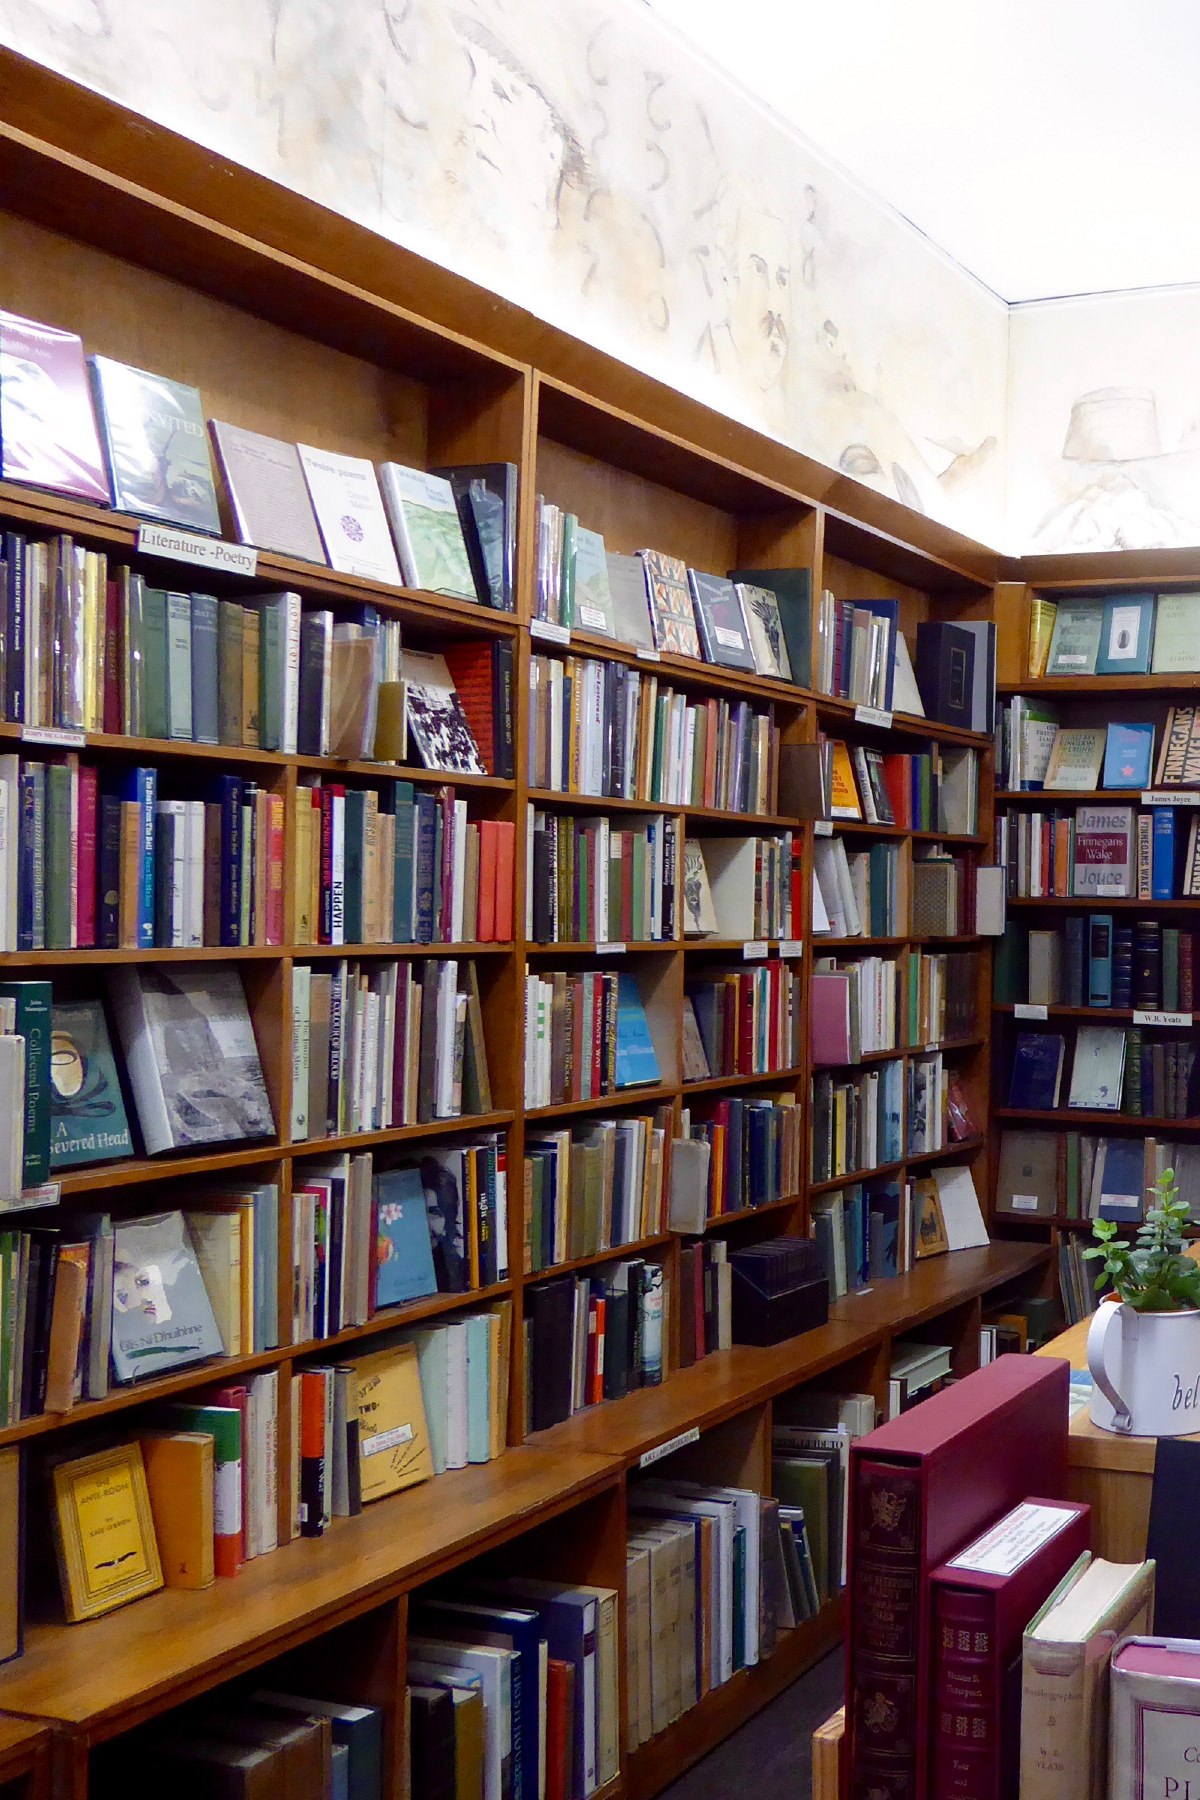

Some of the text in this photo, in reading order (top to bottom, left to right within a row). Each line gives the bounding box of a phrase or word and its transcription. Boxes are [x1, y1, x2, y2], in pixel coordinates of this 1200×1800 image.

[141, 528, 206, 557] Literature
[1163, 706, 1194, 785] FINNEGANS
[1150, 794, 1192, 805] James Joyce
[1078, 810, 1127, 829] James
[1077, 836, 1124, 849] Finnegans
[1086, 849, 1113, 860] Wake
[1140, 821, 1150, 893] FINNEGANS WAKE
[333, 881, 343, 928] HAPPEN
[333, 1000, 341, 1035] COLOUR
[1162, 1015, 1182, 1024] Yeats
[332, 1036, 340, 1049] OF
[331, 1050, 340, 1080] BLOOD
[26, 1028, 42, 1134] Collected Poems
[56, 1121, 67, 1138] A
[97, 1128, 129, 1149] Head
[154, 1323, 203, 1344] Dhuibhne
[946, 1684, 983, 1699] Thompson
